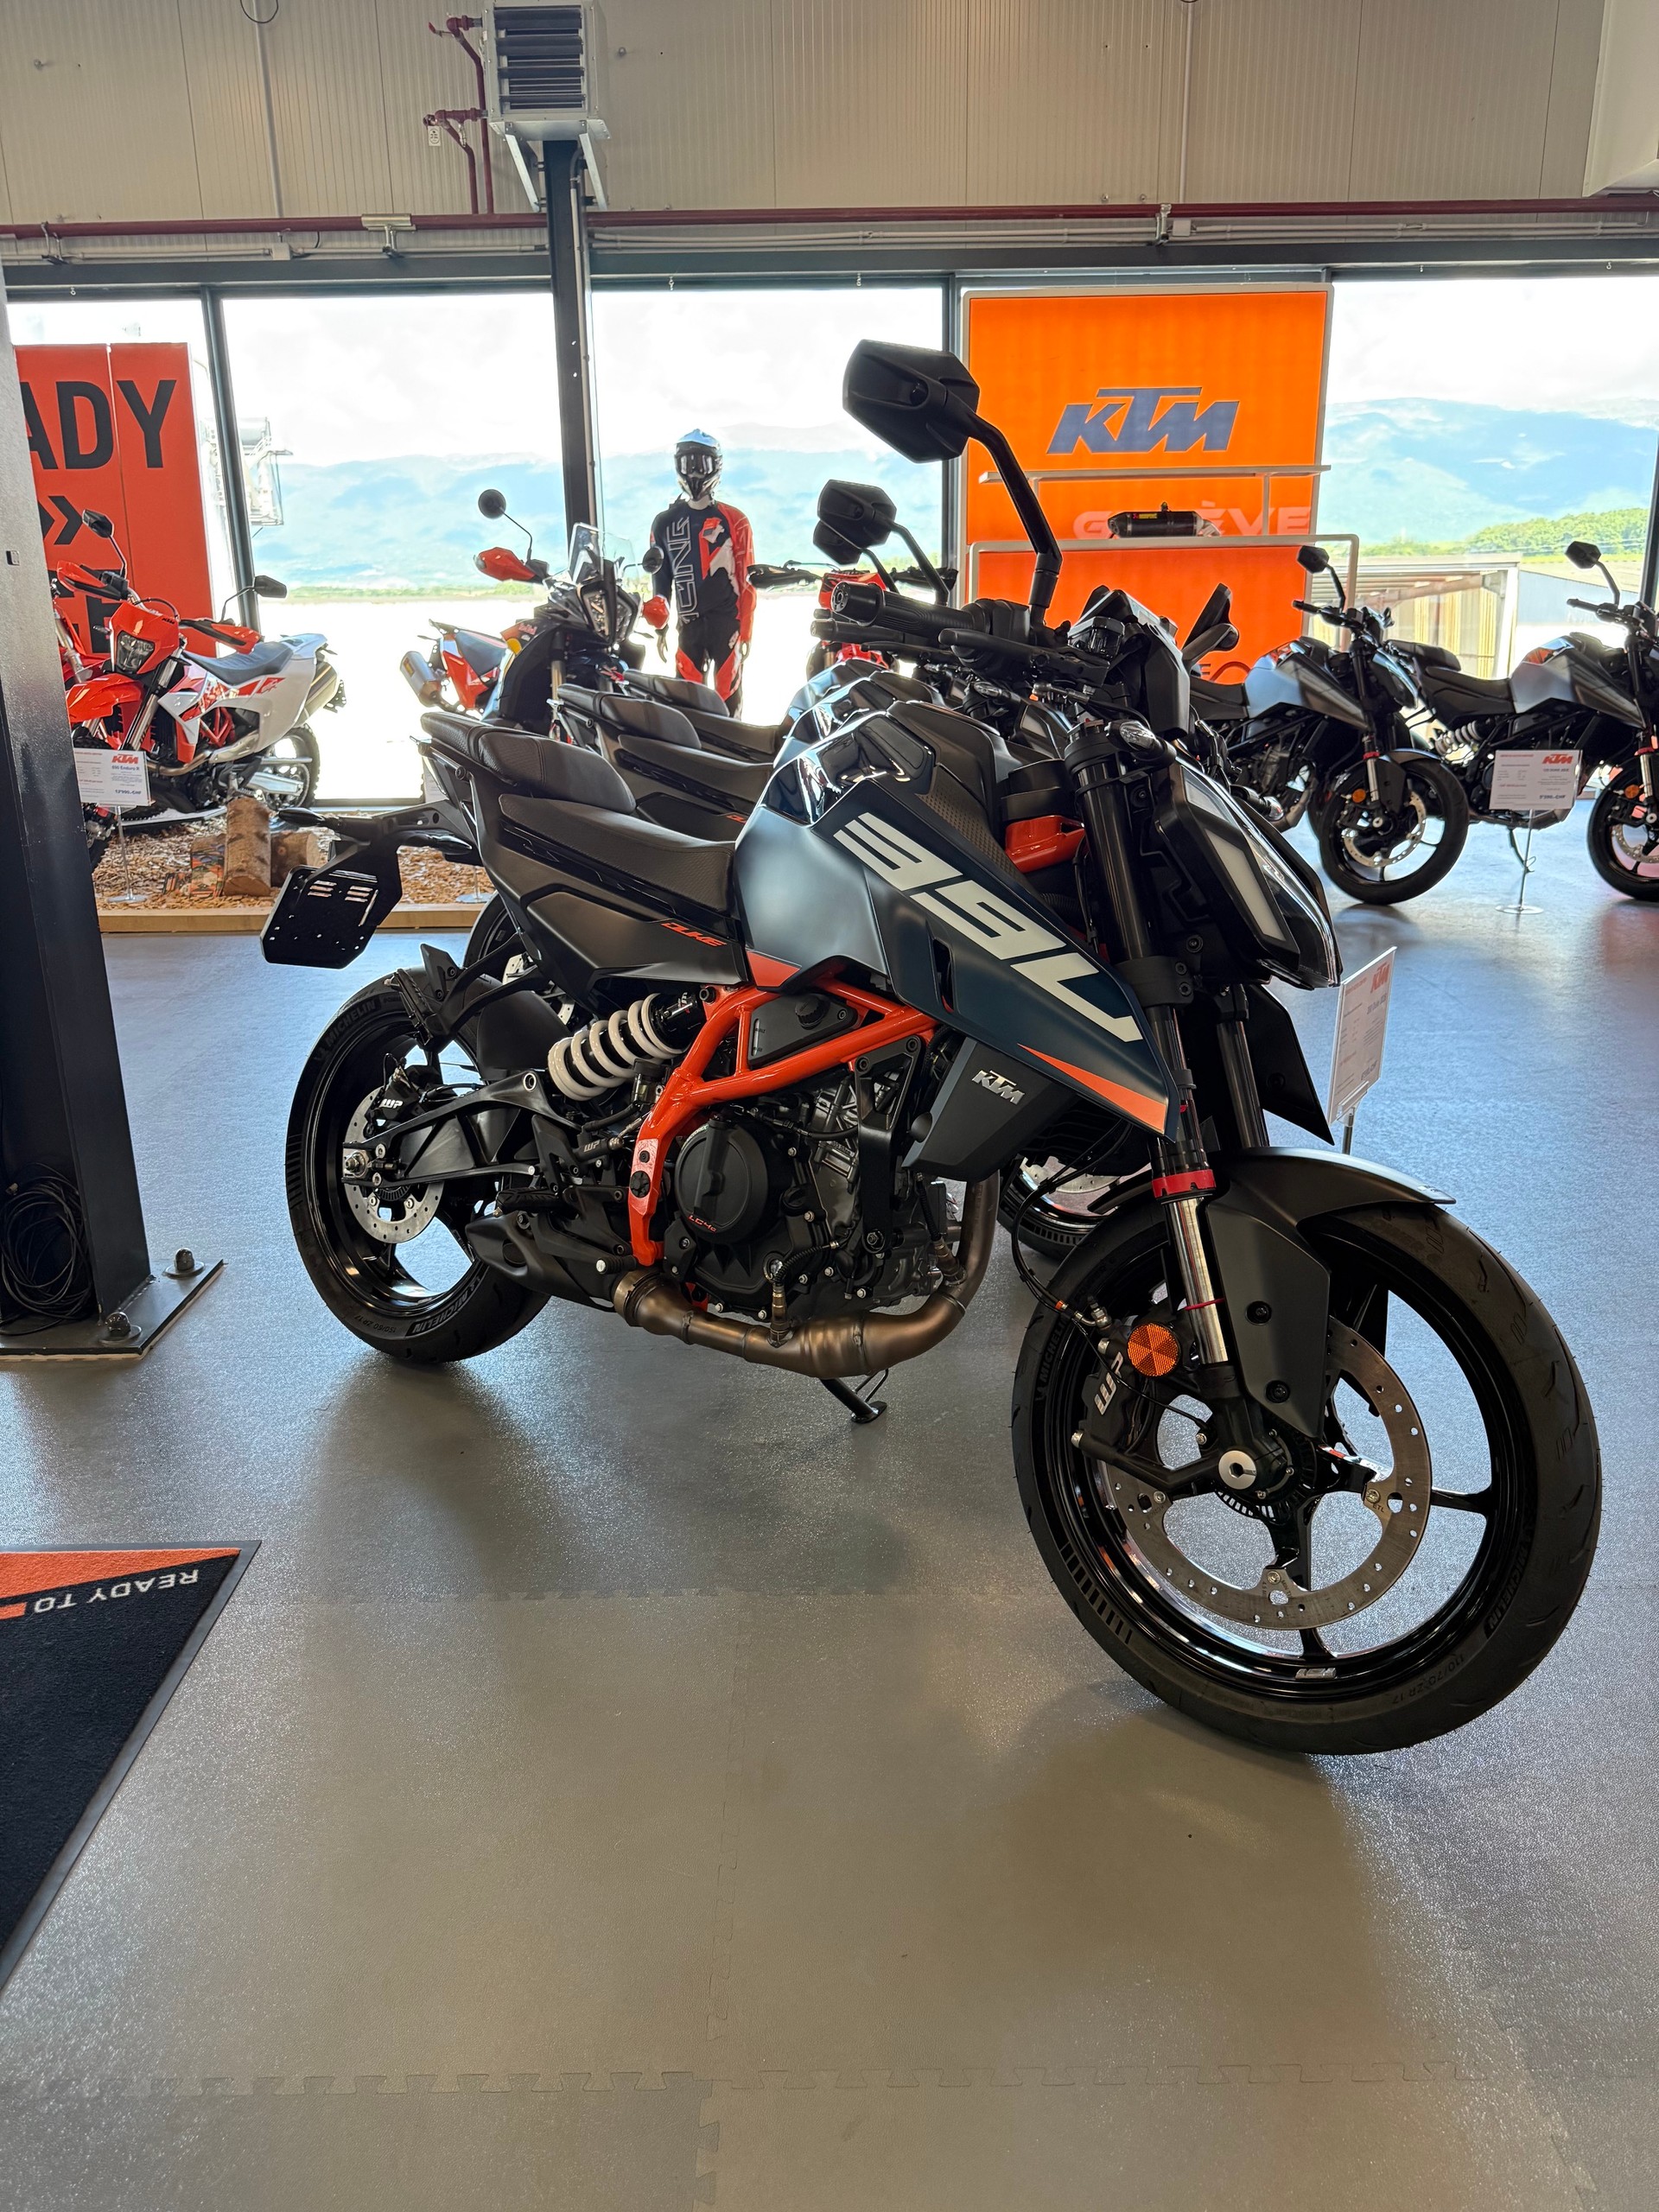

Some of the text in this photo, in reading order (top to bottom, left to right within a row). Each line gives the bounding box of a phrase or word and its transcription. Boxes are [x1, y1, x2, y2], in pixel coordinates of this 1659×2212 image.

[1046, 386, 1240, 454] KTM
[1072, 500, 1312, 537] GÈVE
[111, 753, 139, 764] KTM
[1542, 753, 1573, 764] KTM
[661, 922, 728, 947] DUKE
[1370, 961, 1390, 994] KTM
[325, 998, 377, 1047] MICHELIN
[379, 1098, 404, 1109] WP
[971, 1070, 1026, 1105] KTM
[583, 1140, 601, 1153] WP
[373, 1323, 397, 1334] 150/60
[412, 1289, 469, 1333] MICHELIN
[1039, 1311, 1071, 1384] MICHELI
[1094, 1351, 1124, 1416] WP
[34, 1568, 200, 1614] READY TO
